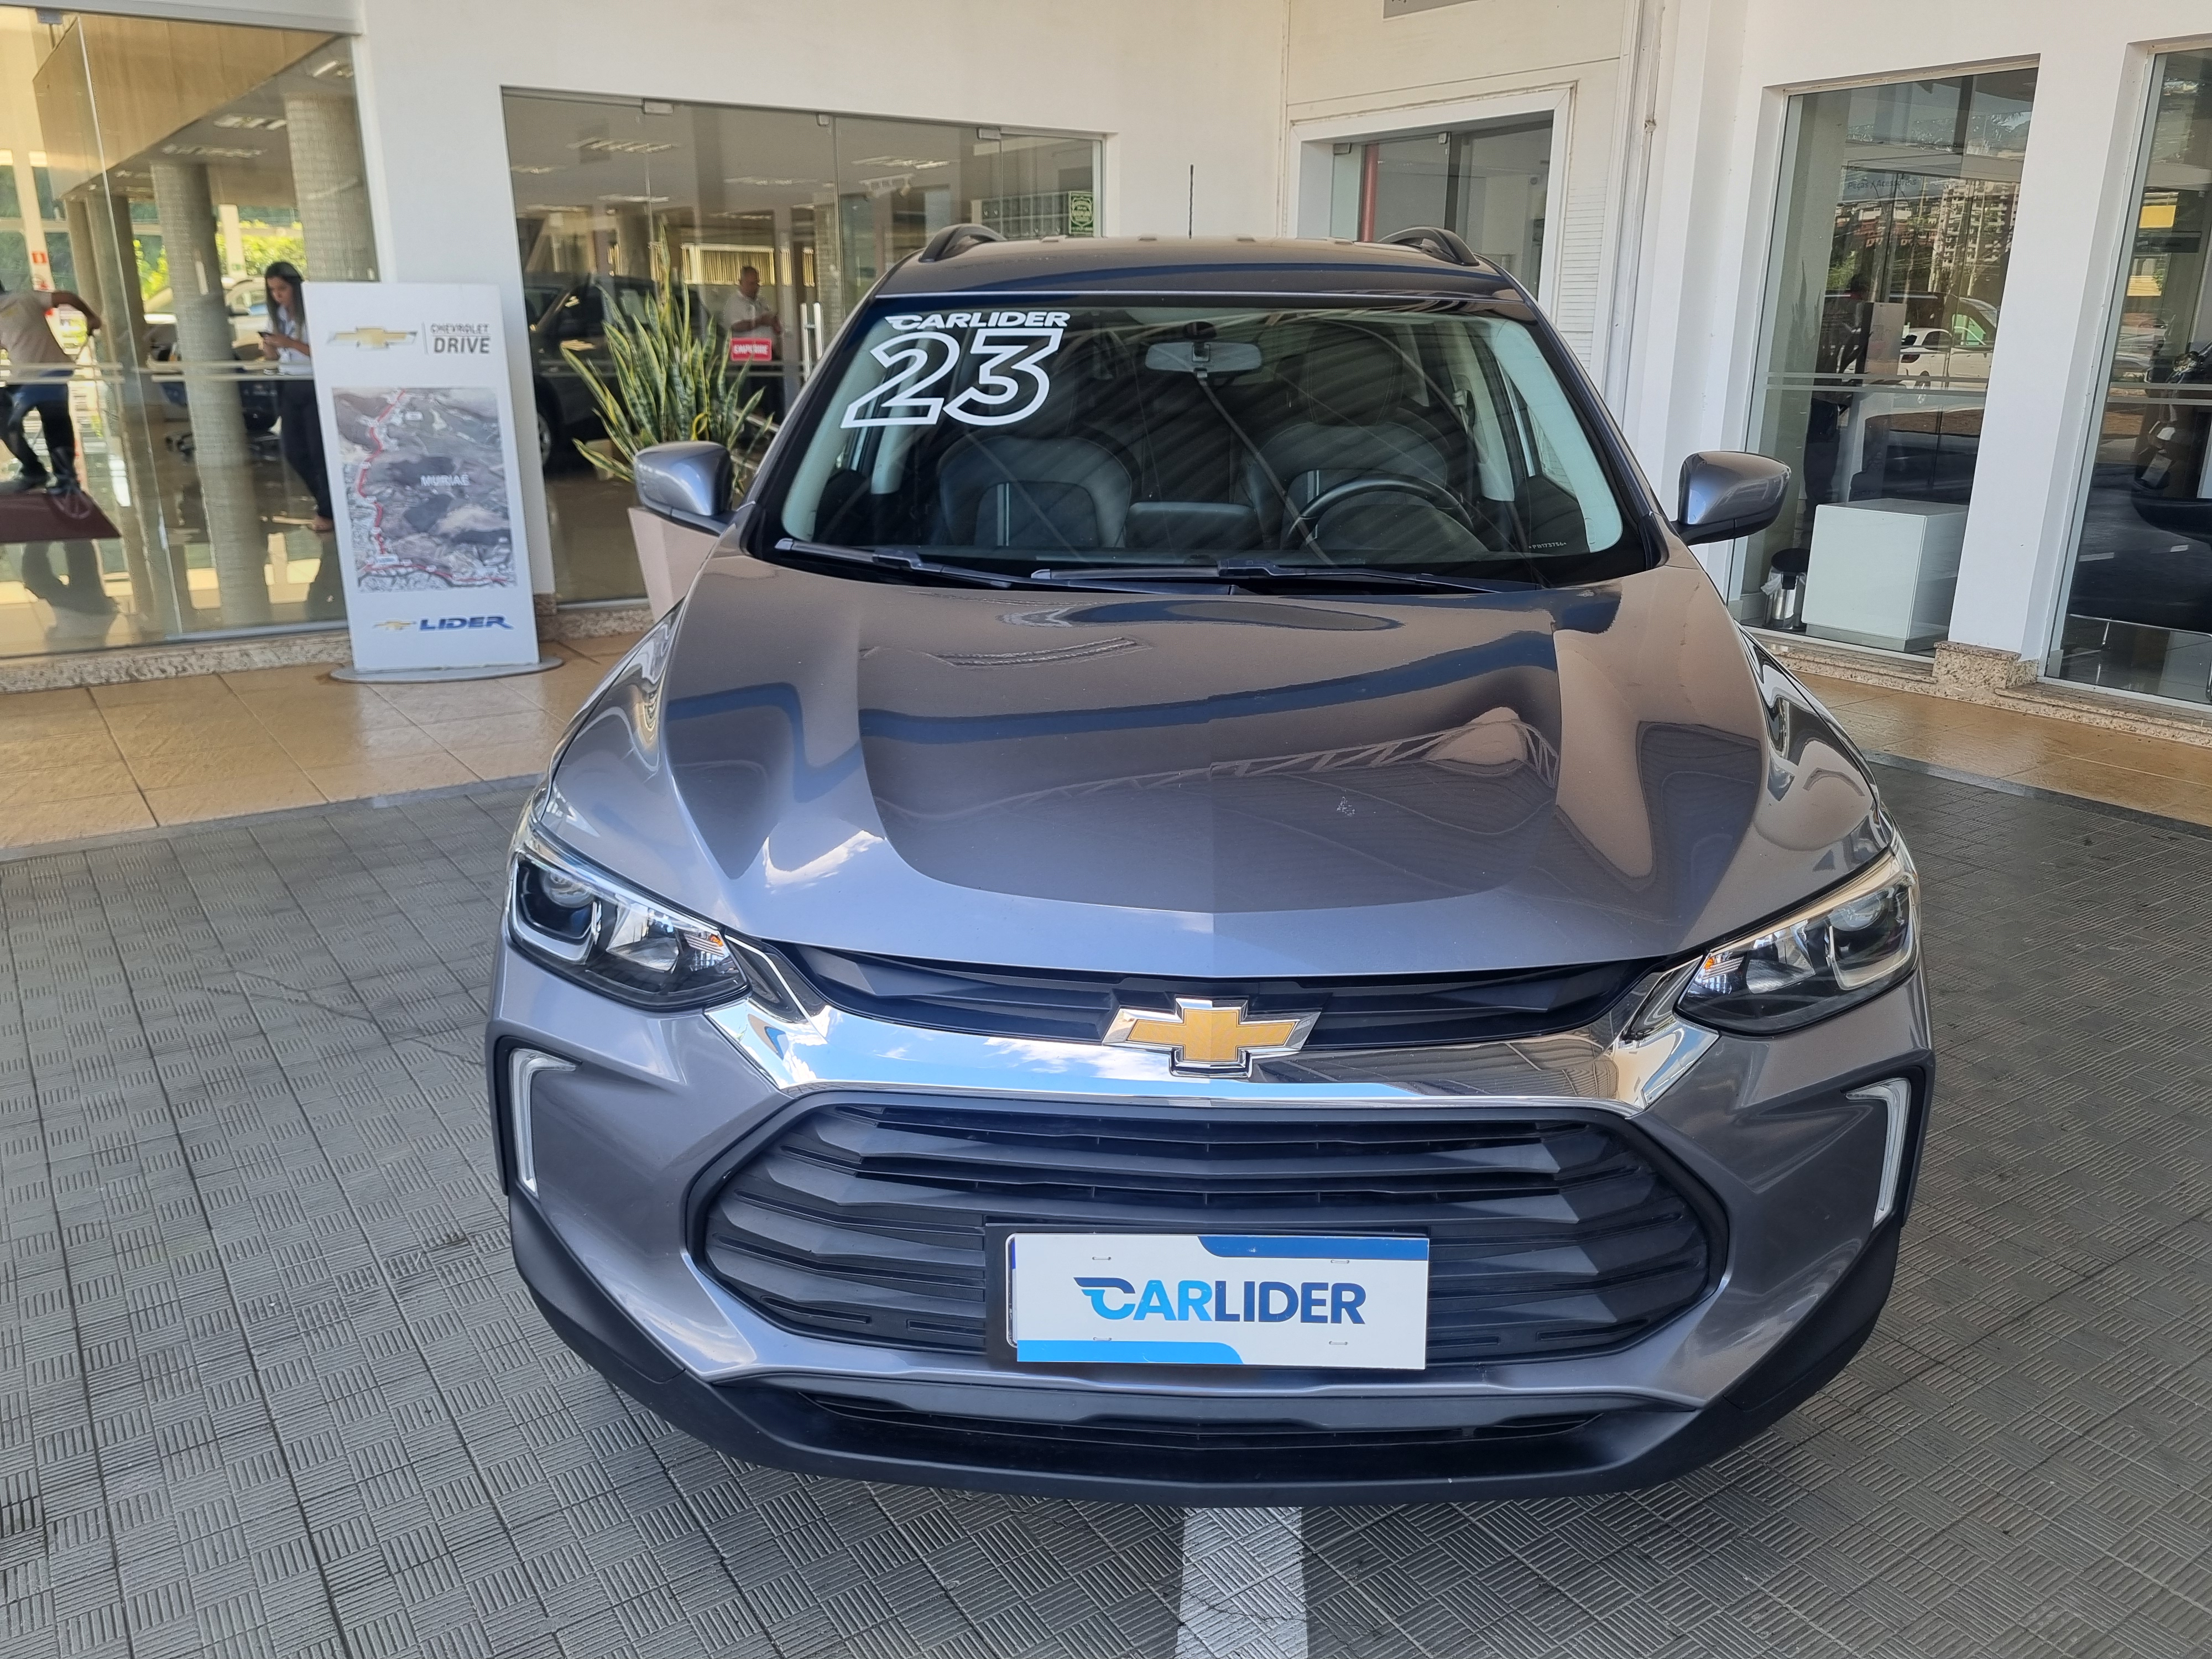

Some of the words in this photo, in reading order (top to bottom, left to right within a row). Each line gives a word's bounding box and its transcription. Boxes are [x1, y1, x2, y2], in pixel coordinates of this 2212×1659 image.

[885, 312, 1071, 330] CARLIDER
[434, 337, 490, 353] DRIVE
[840, 328, 1063, 429] 23
[420, 615, 514, 631] LIDER
[1073, 1277, 1366, 1324] CARLIDER
